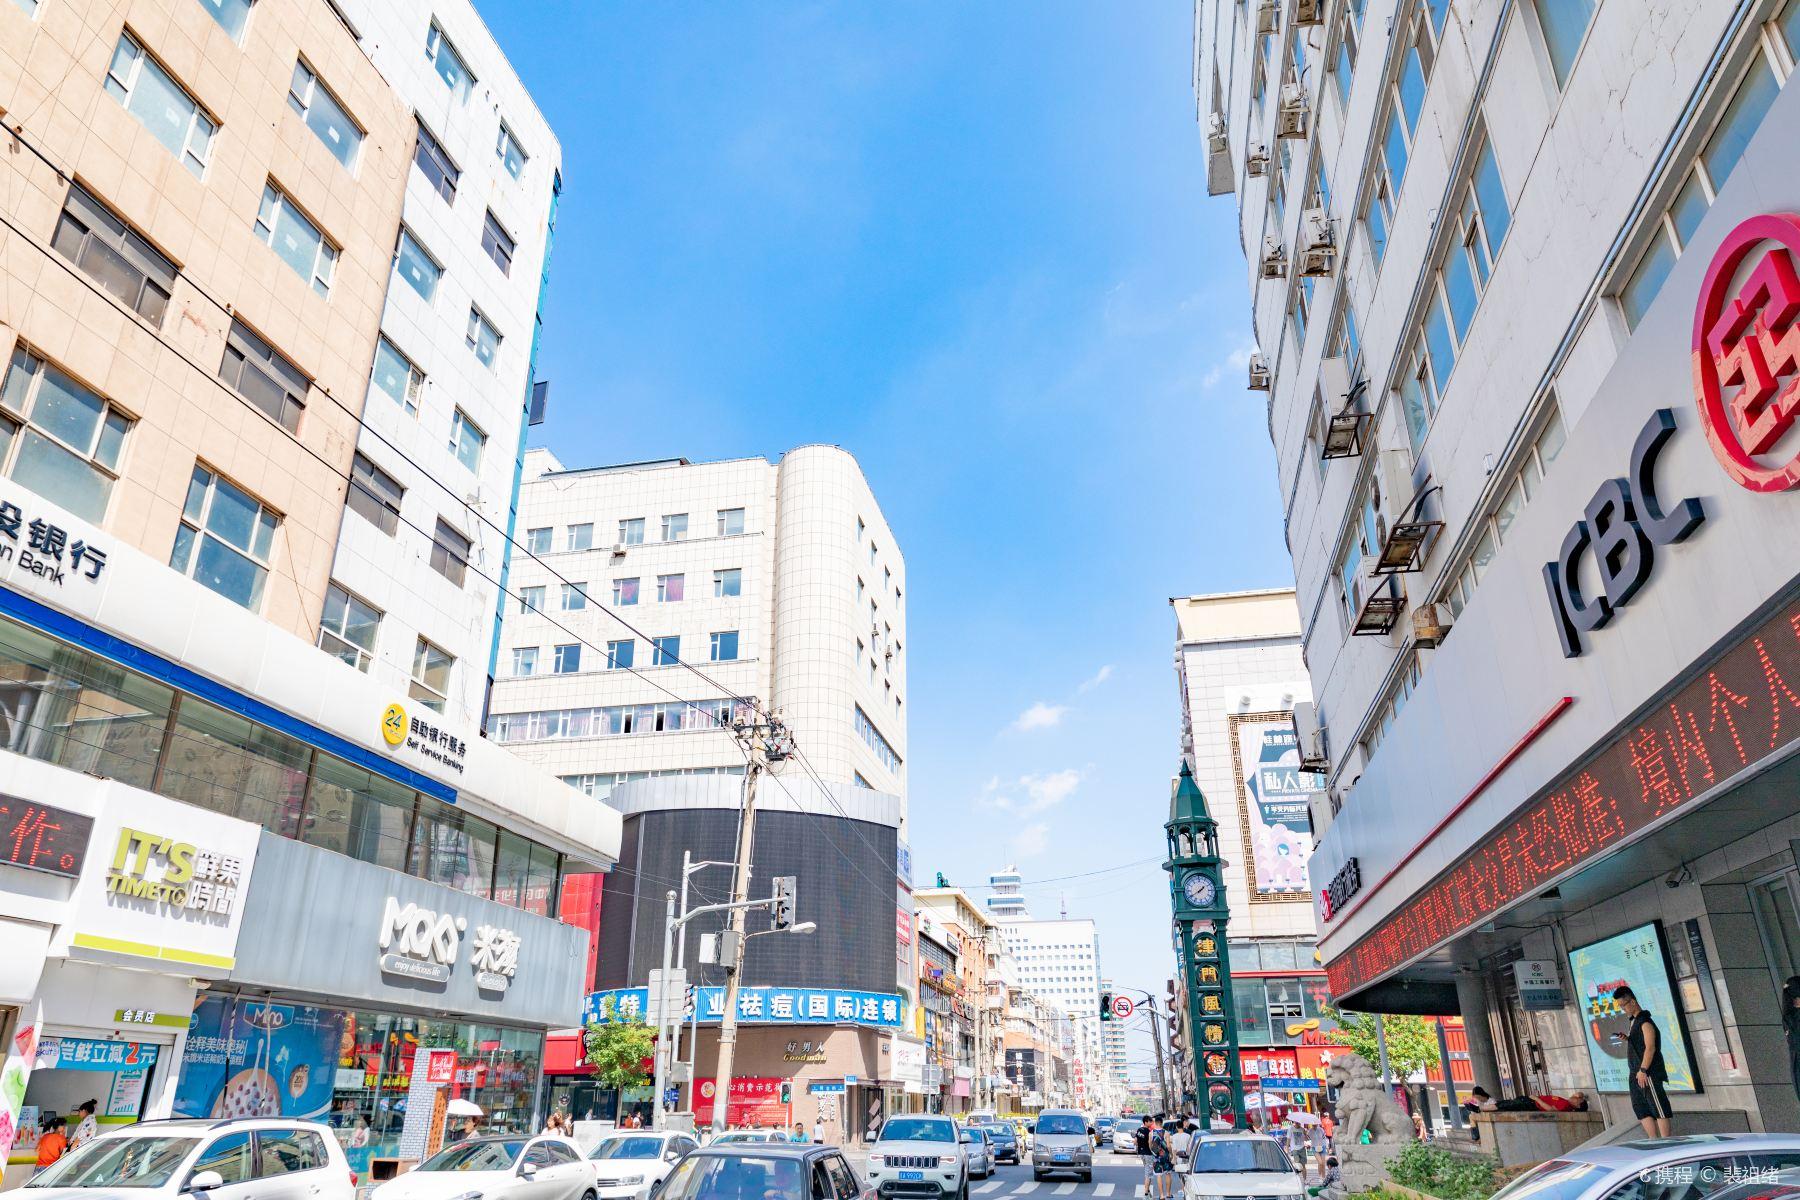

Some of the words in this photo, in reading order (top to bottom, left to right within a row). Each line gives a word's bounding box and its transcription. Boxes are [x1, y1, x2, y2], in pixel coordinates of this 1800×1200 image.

[1542, 408, 1705, 658] ICBC
[18, 550, 64, 586] Bank
[385, 709, 402, 730] 24
[410, 716, 466, 757] 自助银行服务
[407, 737, 419, 751] Self
[420, 745, 442, 761] Service
[443, 756, 464, 774] Banking
[0, 806, 75, 870] 作。
[112, 827, 198, 883] IT'S
[123, 1010, 155, 1023] 会员店
[61, 1041, 156, 1064] 尝鲜立减2元
[783, 1053, 827, 1064] Goodman
[787, 1042, 824, 1053] 好男人
[728, 1083, 781, 1092] 心消费示范
